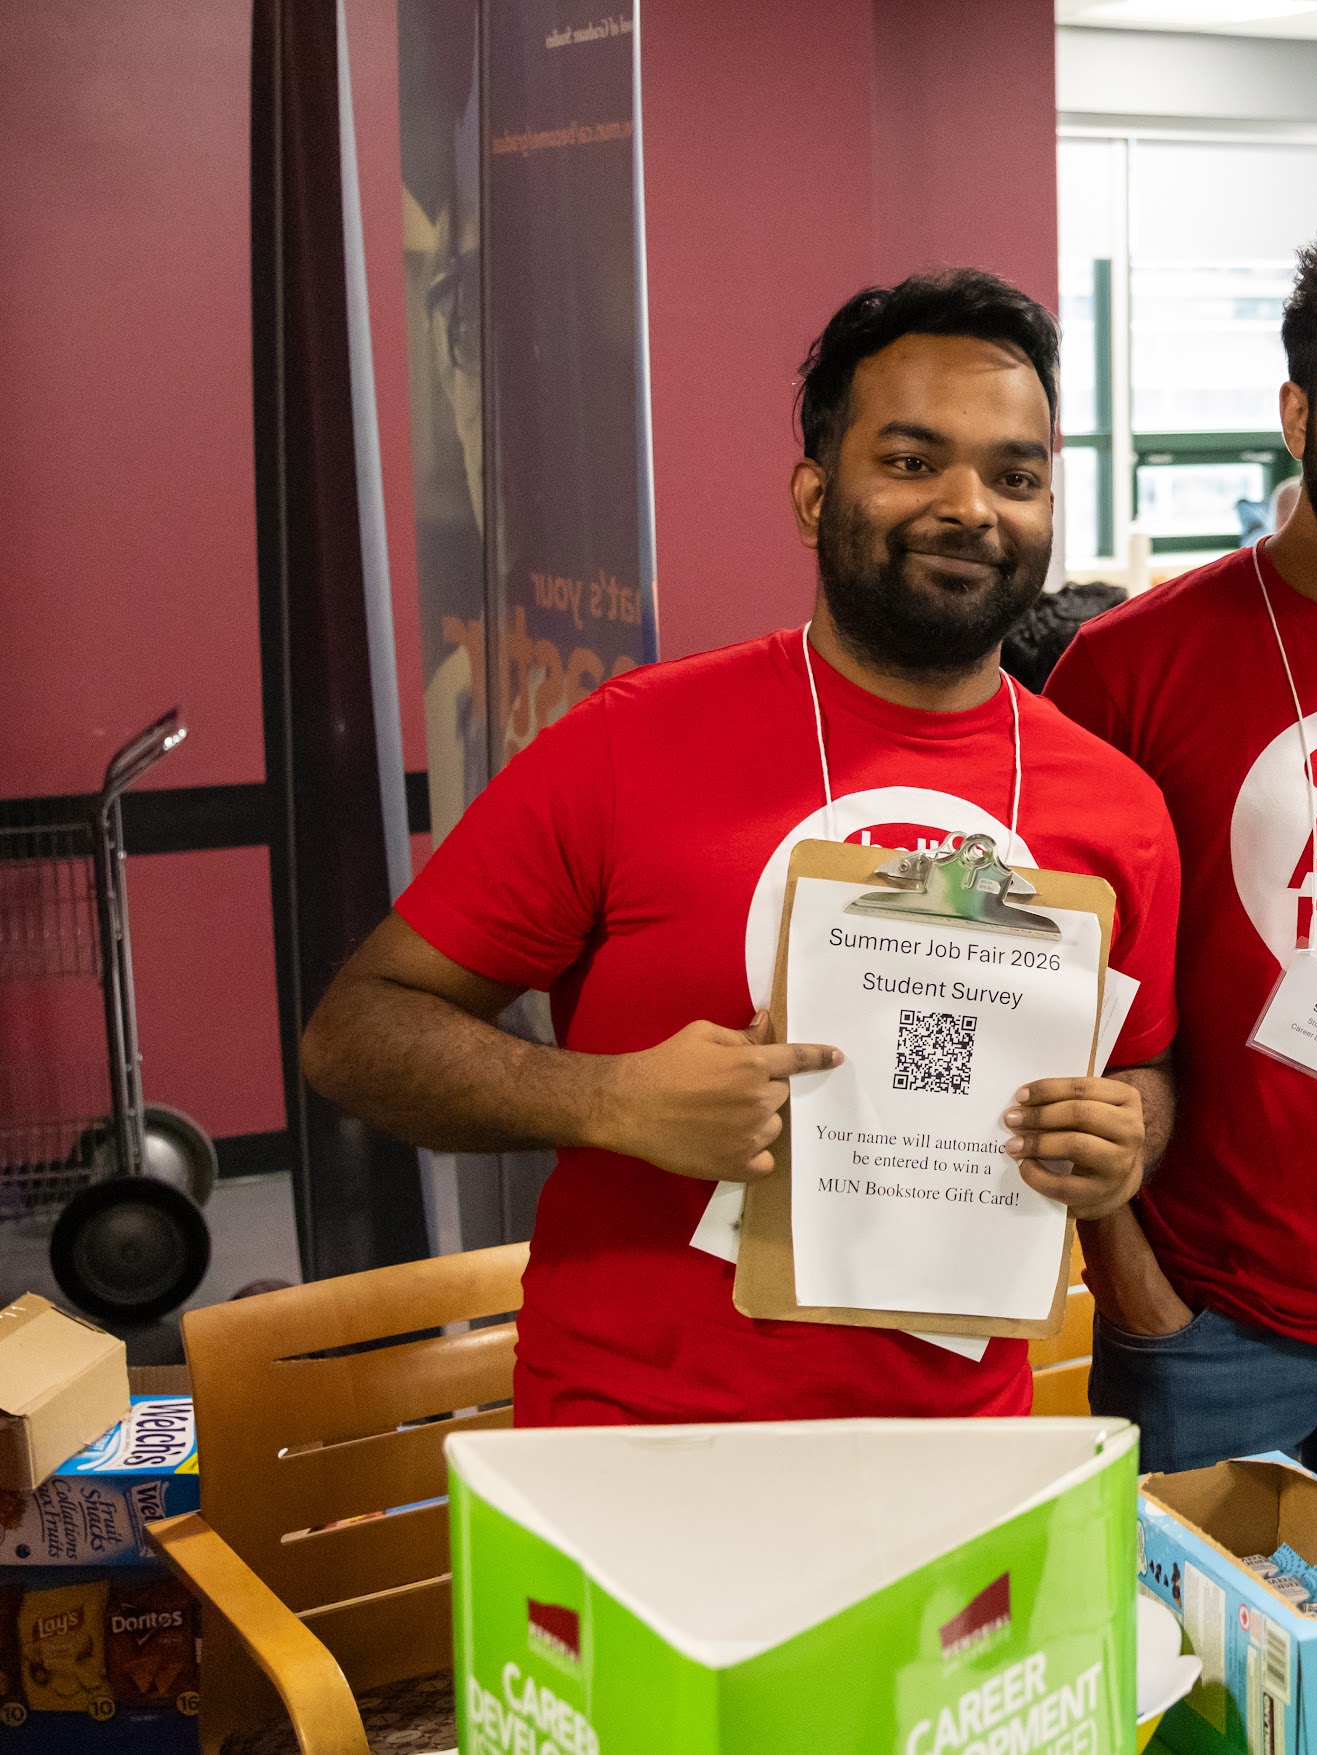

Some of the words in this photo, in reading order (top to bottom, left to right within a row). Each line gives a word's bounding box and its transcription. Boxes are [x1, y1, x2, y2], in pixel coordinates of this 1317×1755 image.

[829, 927, 921, 956] Summer
[925, 939, 961, 961] Job
[967, 943, 1004, 966] Fair
[1010, 949, 1062, 972] 2026
[862, 971, 946, 999] Student
[951, 981, 1023, 1009] Survey
[1291, 1023, 1314, 1040] Career
[816, 1124, 854, 1144] Your
[857, 1131, 897, 1146] name
[902, 1134, 931, 1149] will
[852, 1151, 870, 1166] be
[874, 1154, 929, 1171] entered
[933, 1158, 948, 1172] to
[953, 1160, 980, 1175] win
[983, 1166, 992, 1176] a
[818, 1177, 861, 1195] MUN
[865, 1181, 941, 1201] Bookstore
[945, 1186, 975, 1203] Gift
[978, 1190, 1020, 1207] Card!
[123, 1402, 193, 1466] Welch's
[45, 1509, 61, 1559] Fruits
[52, 1478, 78, 1560] Collations
[80, 1487, 105, 1553] Snacks
[99, 1501, 123, 1544] Fruit
[38, 1611, 79, 1639] Lay's
[111, 1610, 183, 1634] Doritos
[93, 1701, 112, 1716] 10
[906, 1651, 1047, 1755] CAREER
